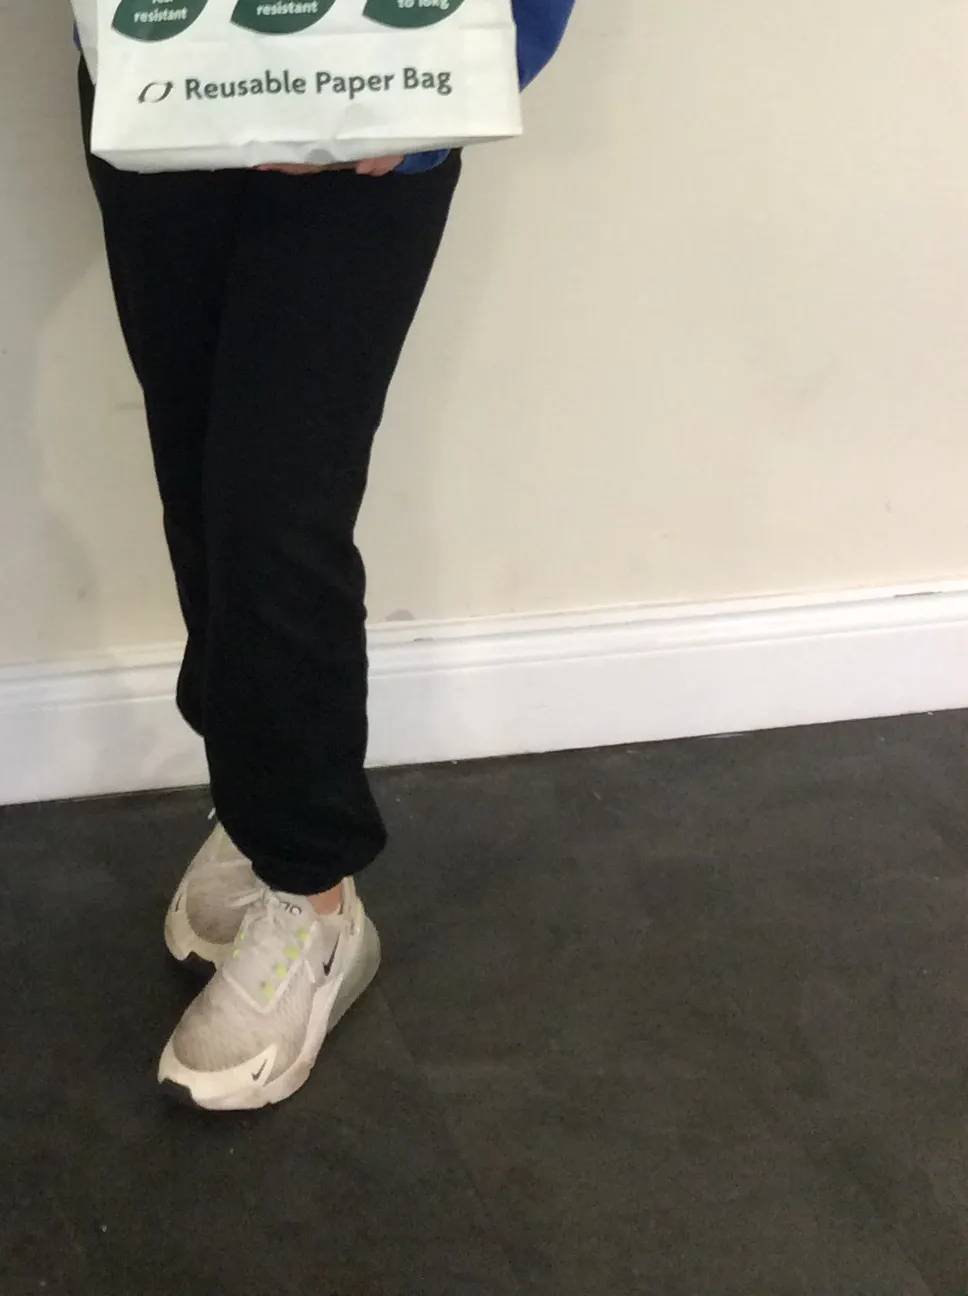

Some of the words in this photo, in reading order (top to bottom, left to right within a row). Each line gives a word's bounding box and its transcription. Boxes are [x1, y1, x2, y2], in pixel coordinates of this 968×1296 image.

[133, 6, 188, 23] resistant
[256, 0, 319, 15] resistant
[185, 69, 307, 100] Reusable
[315, 70, 395, 101] Paper
[403, 67, 453, 97] Bag
